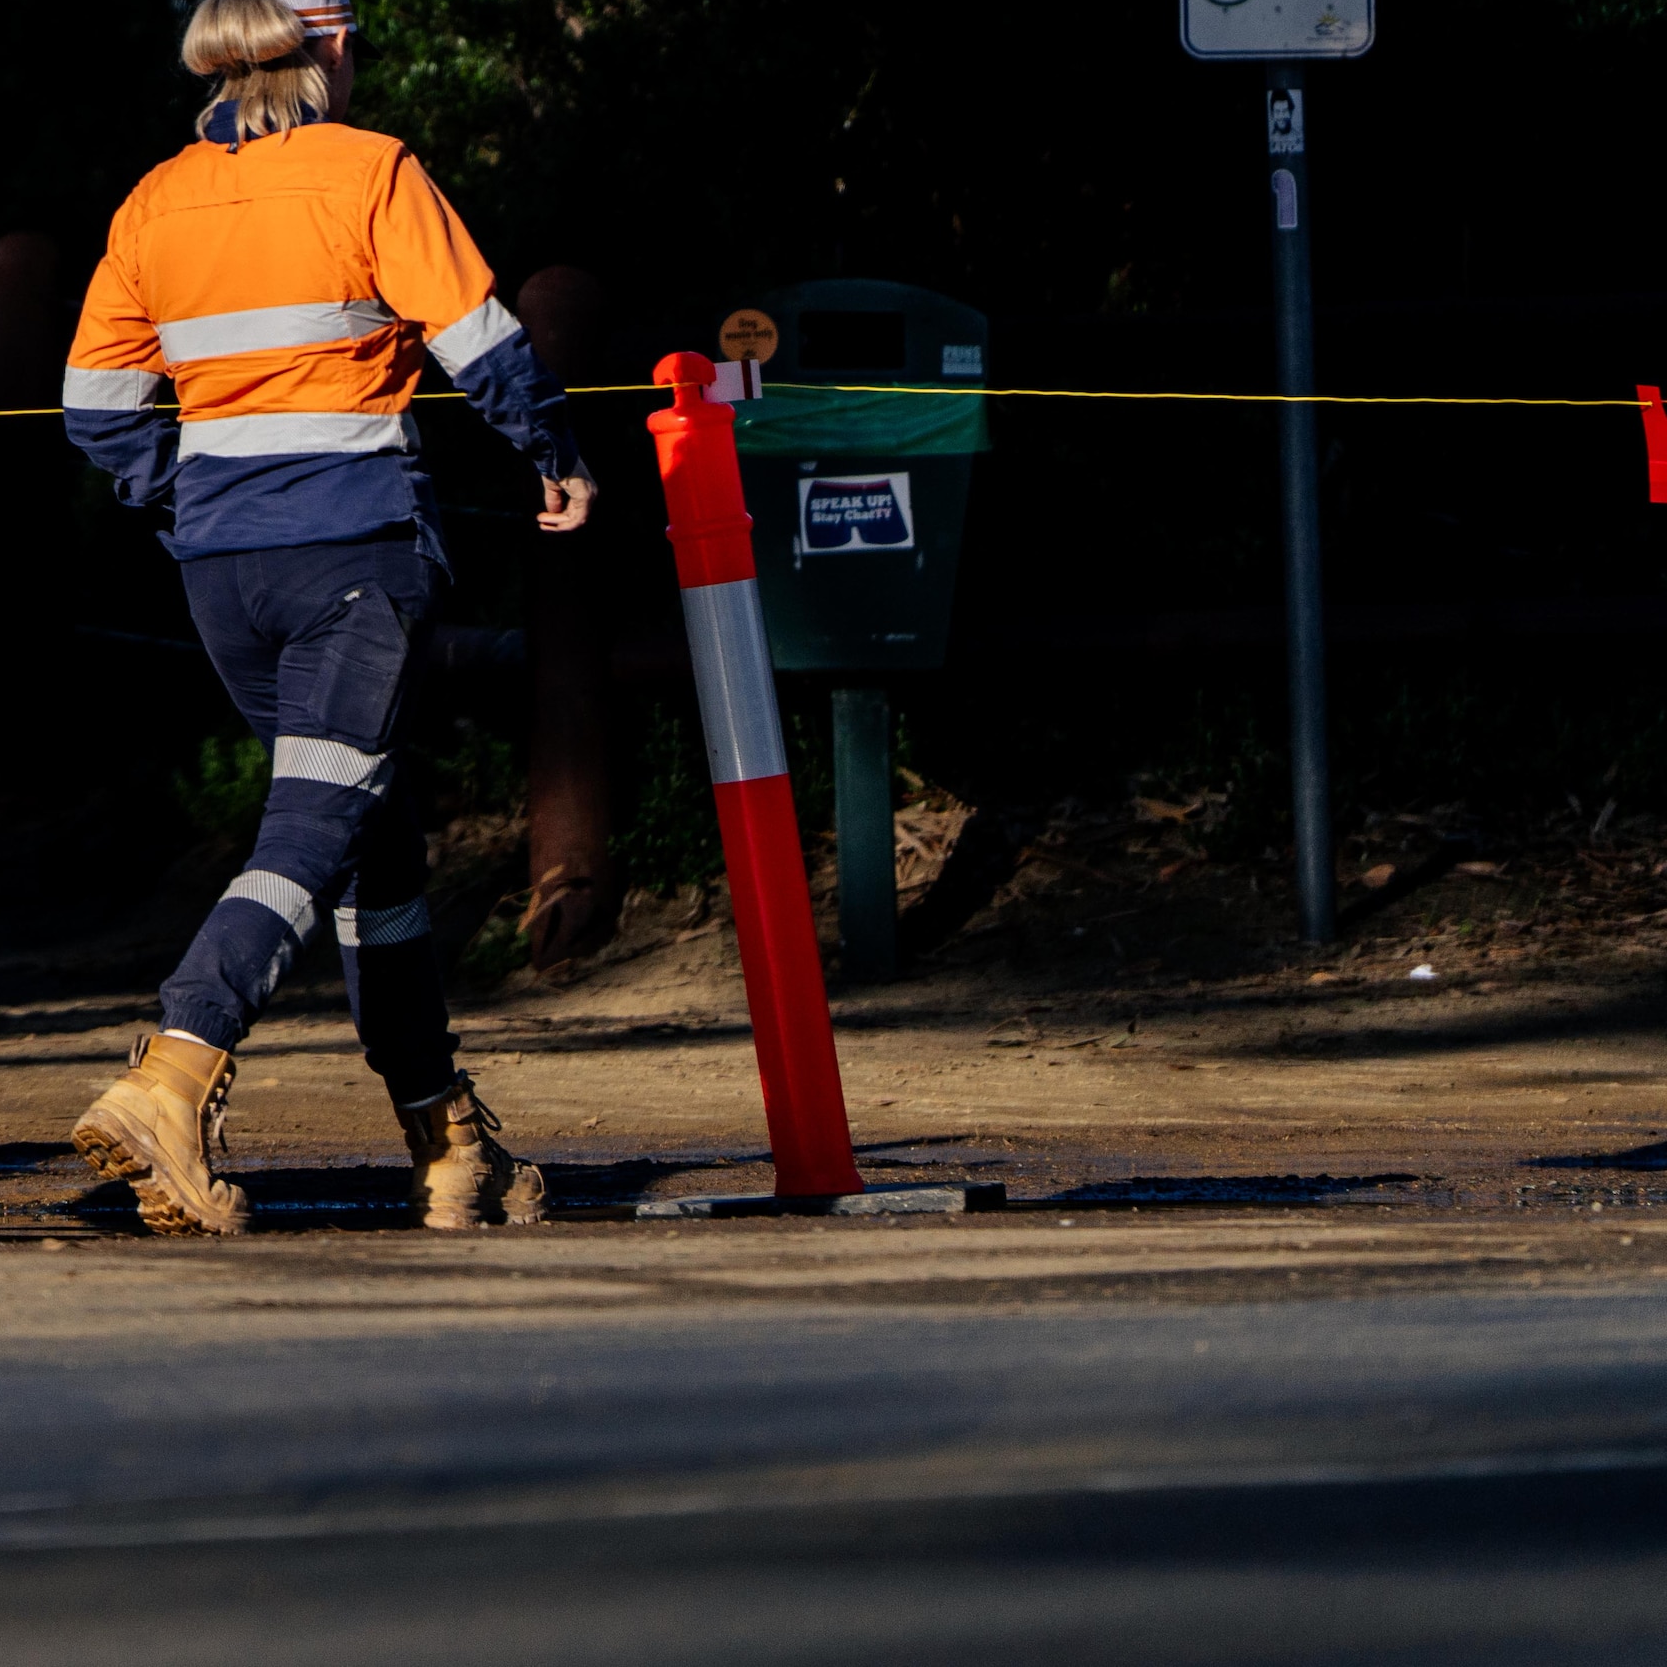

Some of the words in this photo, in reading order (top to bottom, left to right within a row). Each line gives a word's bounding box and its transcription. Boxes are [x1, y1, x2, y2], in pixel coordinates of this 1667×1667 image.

[811, 495, 864, 510] SPEAK
[866, 493, 892, 507] UP!
[812, 511, 842, 526] Stay
